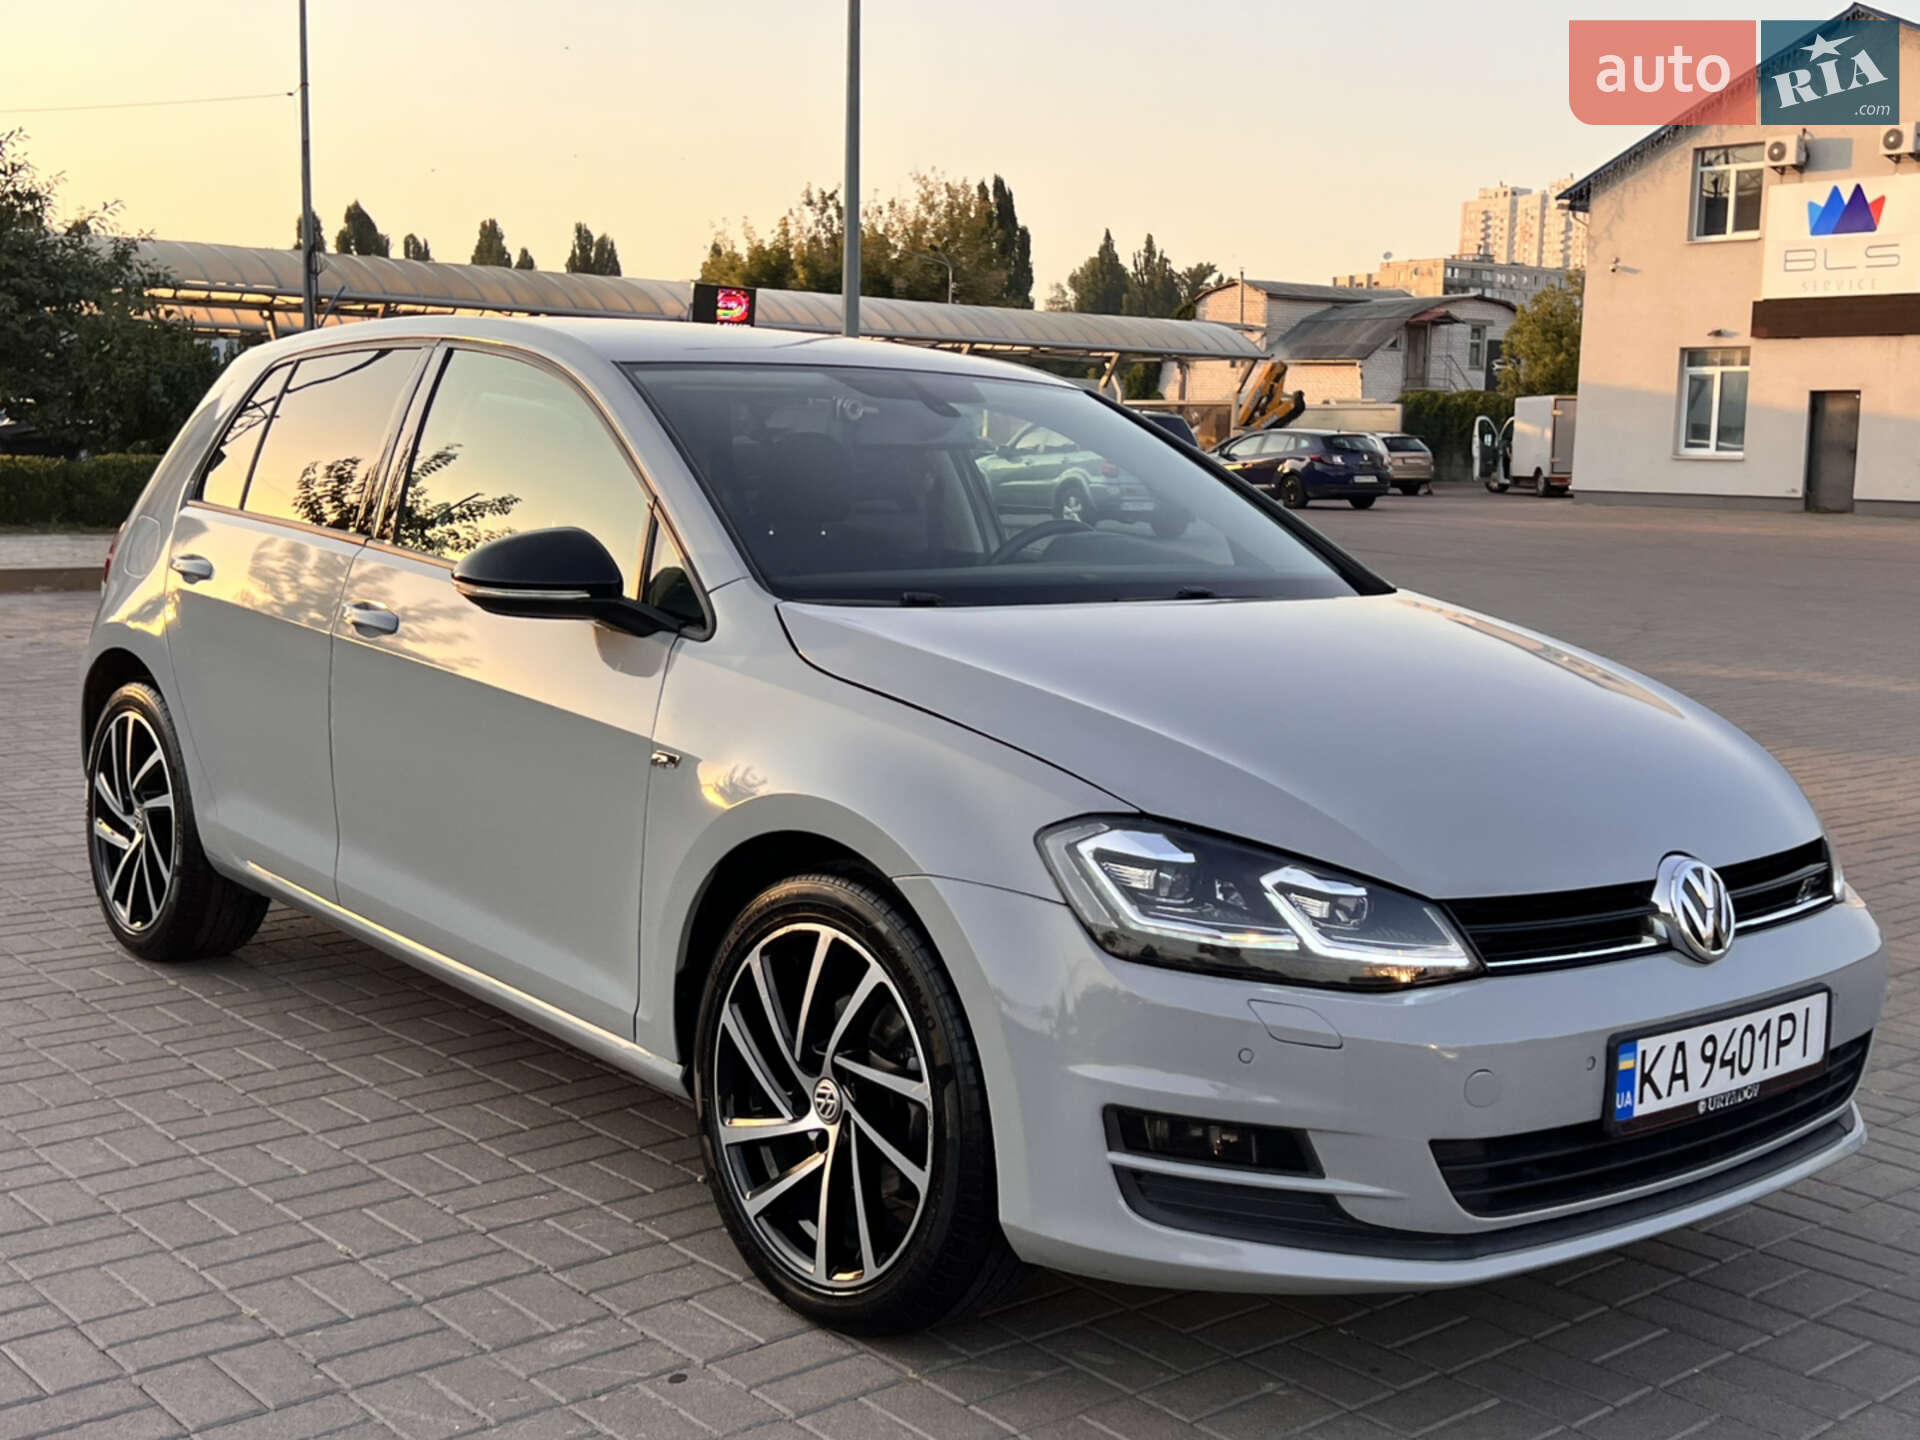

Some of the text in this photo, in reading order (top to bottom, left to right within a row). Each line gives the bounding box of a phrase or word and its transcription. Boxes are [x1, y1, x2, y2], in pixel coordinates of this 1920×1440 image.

[1783, 243, 1900, 273] BLS
[1800, 278, 1879, 293] SERVICE
[1615, 1090, 1634, 1109] UA
